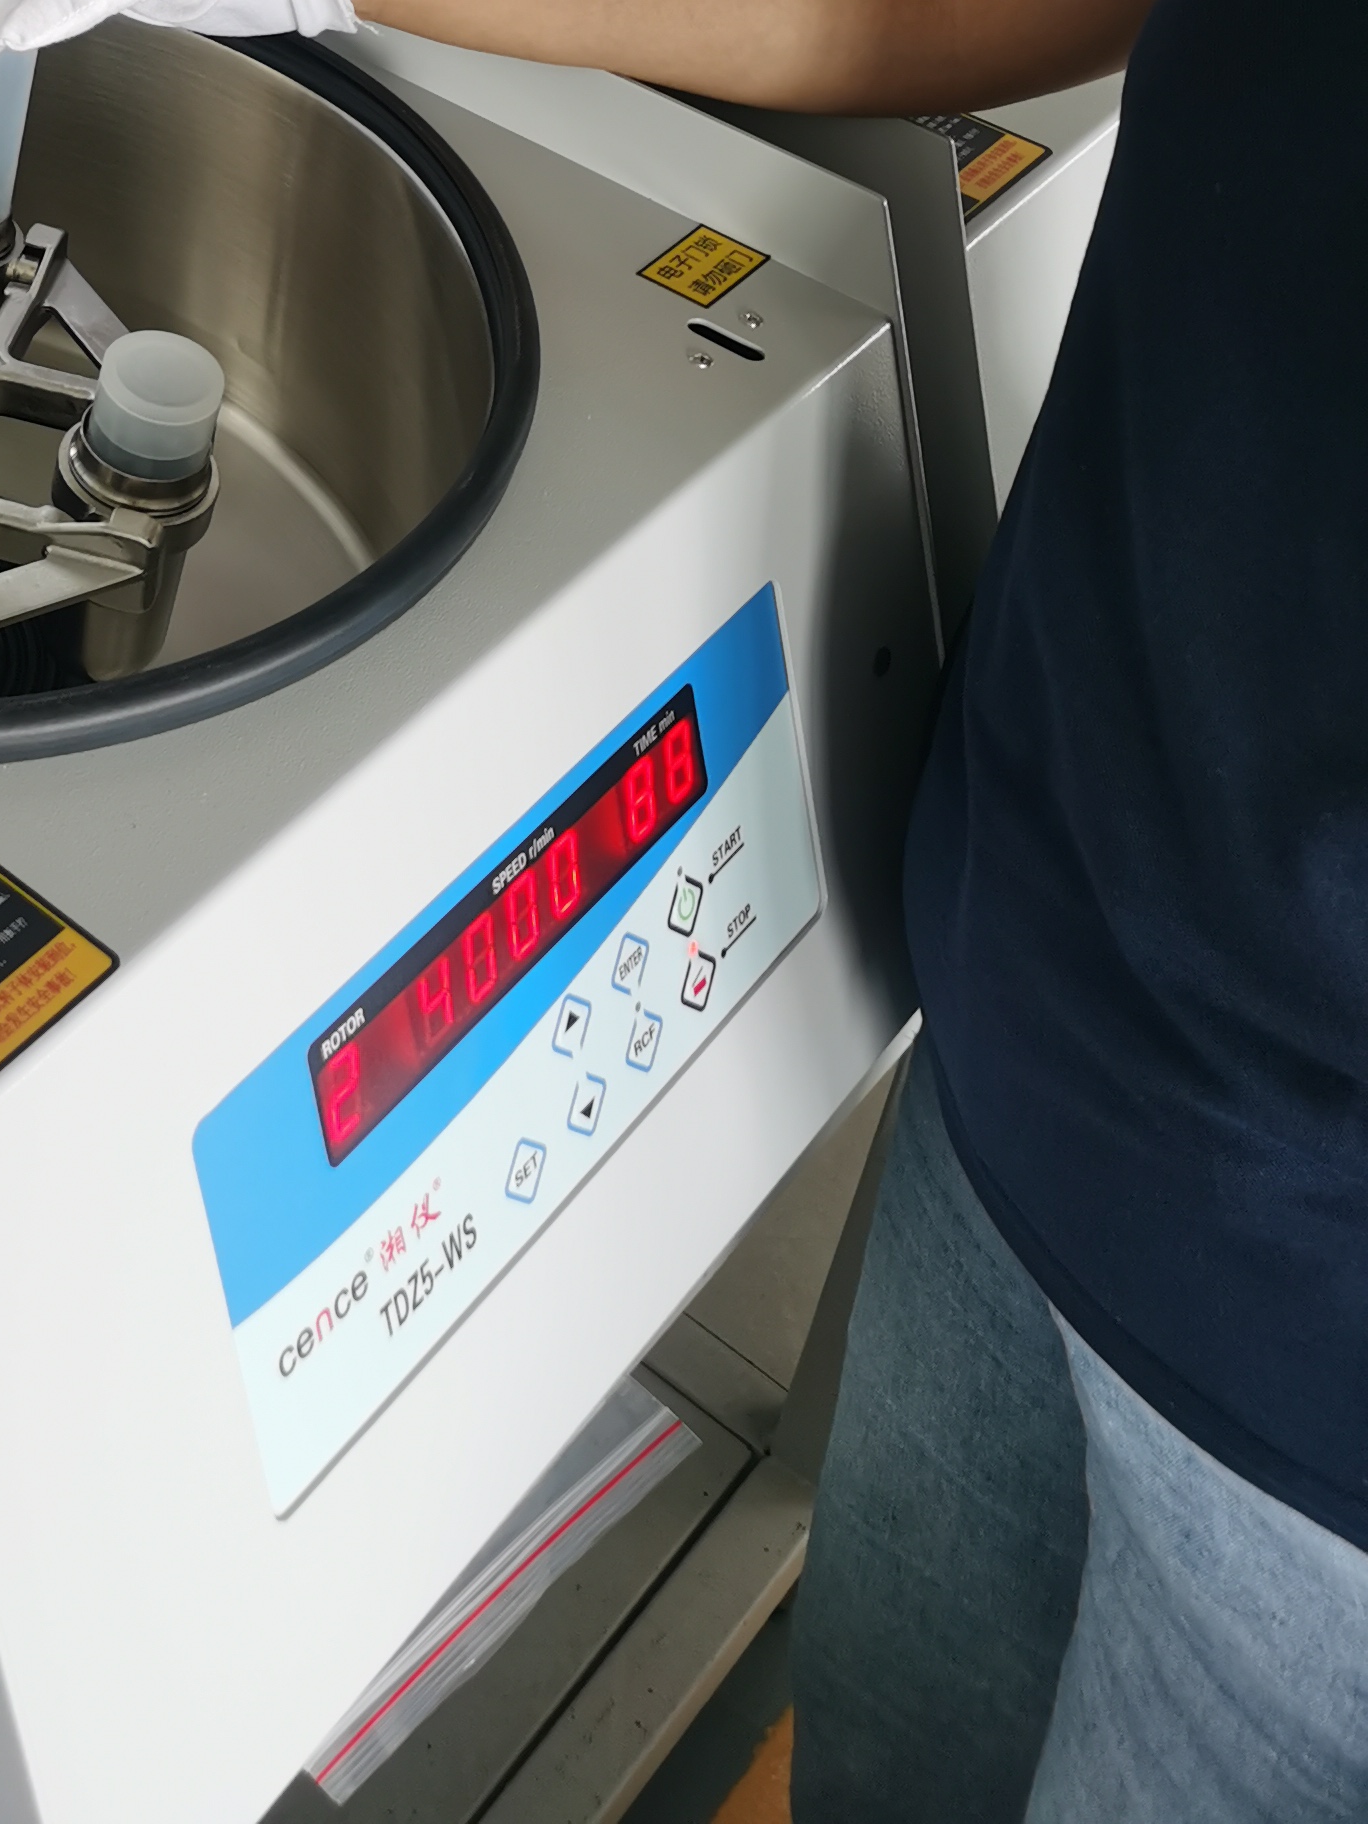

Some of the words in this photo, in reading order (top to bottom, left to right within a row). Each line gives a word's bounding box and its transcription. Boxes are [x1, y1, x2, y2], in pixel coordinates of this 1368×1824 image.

[657, 235, 723, 280] 电子门锁
[688, 250, 753, 296] 请勿砸门
[632, 724, 659, 757] TIME
[659, 709, 676, 734] min
[492, 852, 527, 895] SPEED
[528, 827, 555, 860] r/min
[712, 825, 742, 867] START
[726, 903, 752, 940] STOP
[325, 1040, 361, 1144] 2
[416, 827, 580, 1025] 4000
[618, 946, 644, 981] ENTER
[320, 1007, 366, 1060] ROTOR
[633, 1024, 657, 1057] RCF
[514, 1151, 540, 1189] SET
[380, 1213, 478, 1337] TDZ5-WS
